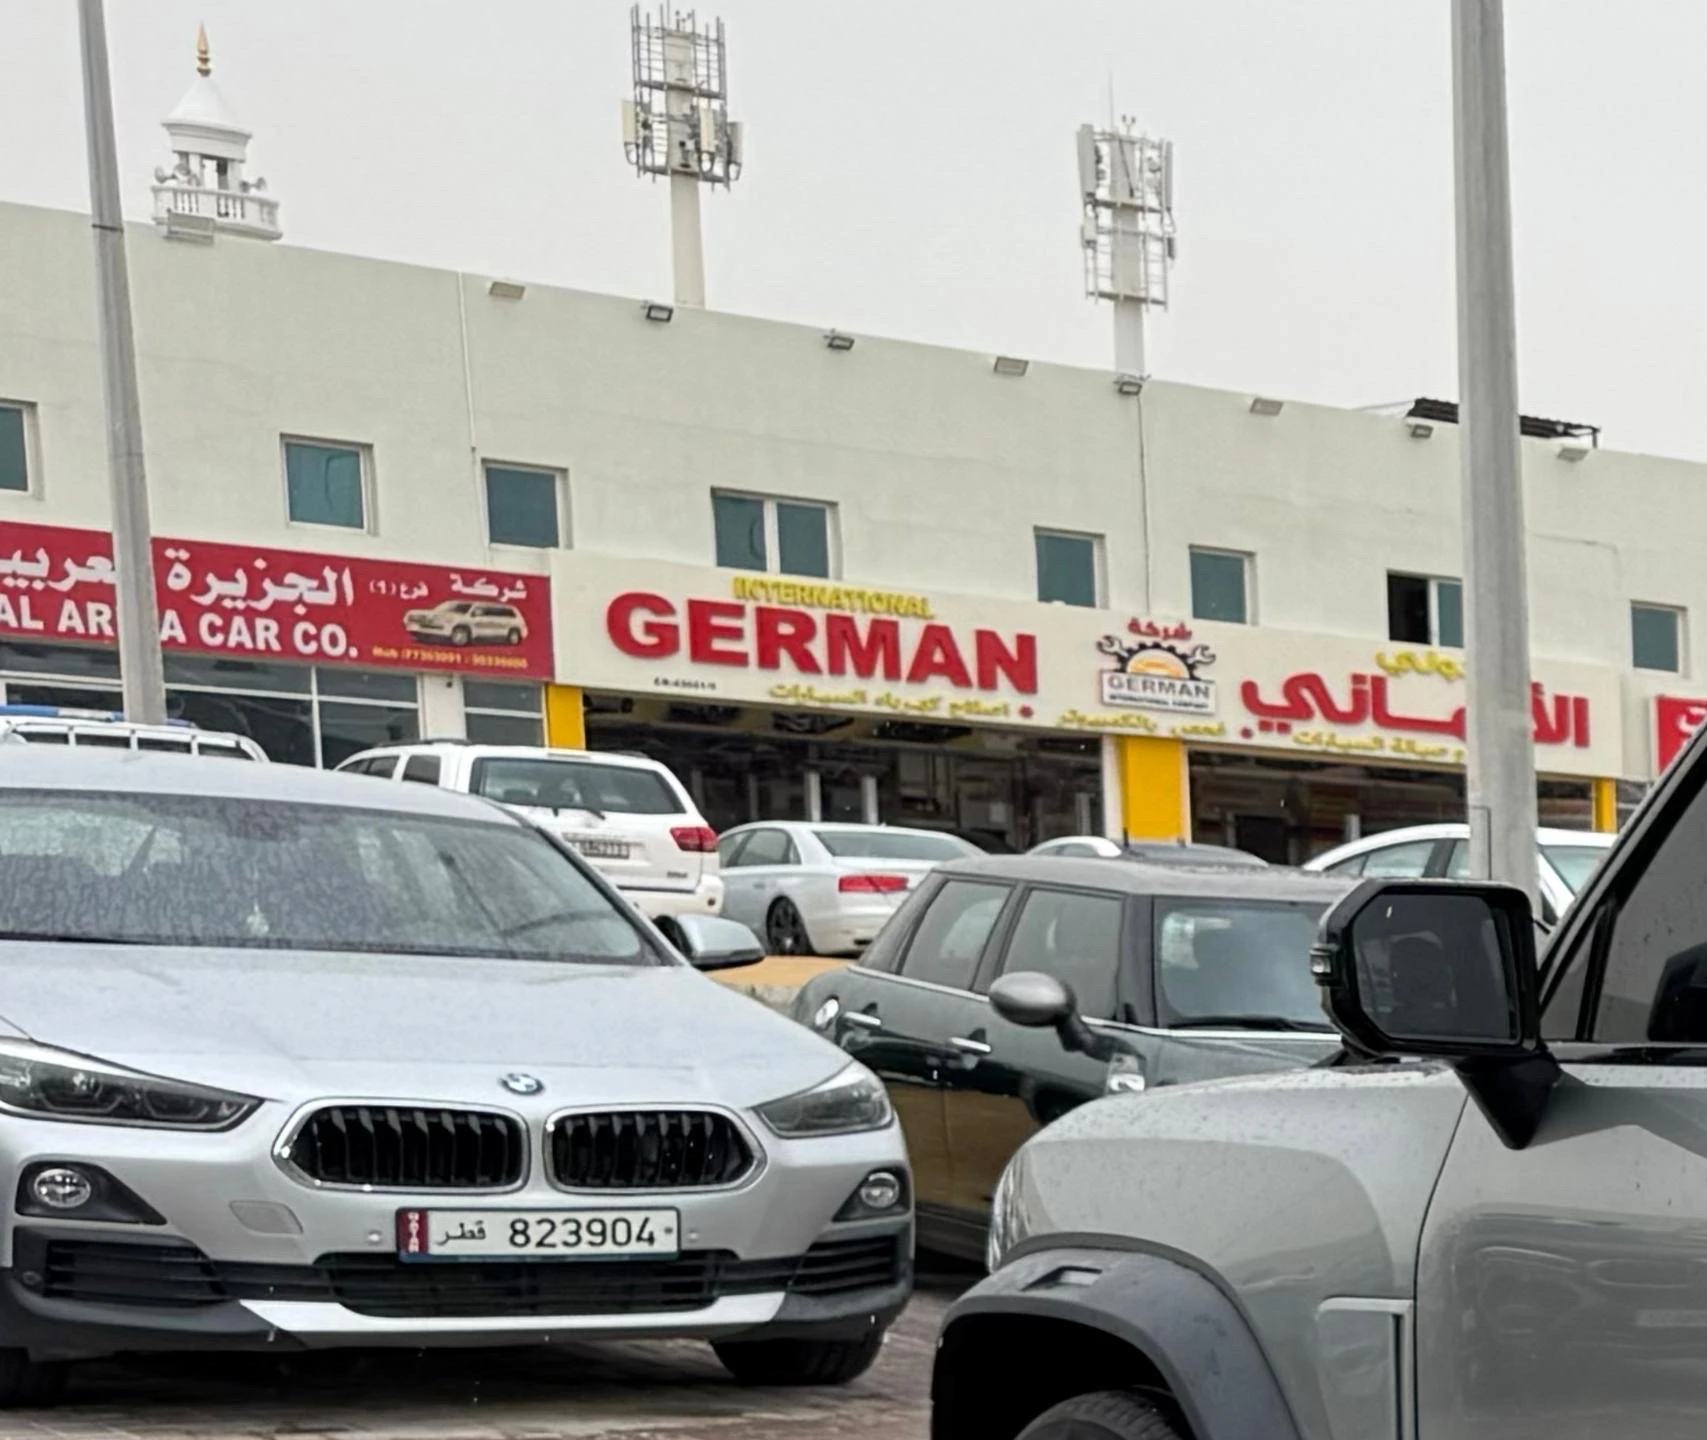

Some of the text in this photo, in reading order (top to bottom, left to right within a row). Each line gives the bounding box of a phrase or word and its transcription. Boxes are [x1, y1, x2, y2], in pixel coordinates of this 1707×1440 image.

[164, 548, 354, 615] الجزيرة
[450, 573, 528, 602] شركة
[733, 576, 934, 620] INTERNATIONAL
[199, 612, 282, 651] CAR
[293, 621, 359, 658] CO.
[606, 591, 1038, 694] GERMAN
[1128, 617, 1192, 641] شركة
[1108, 675, 1210, 700] GERMAN
[436, 1220, 487, 1246] قطر
[509, 1217, 656, 1248] 823904
